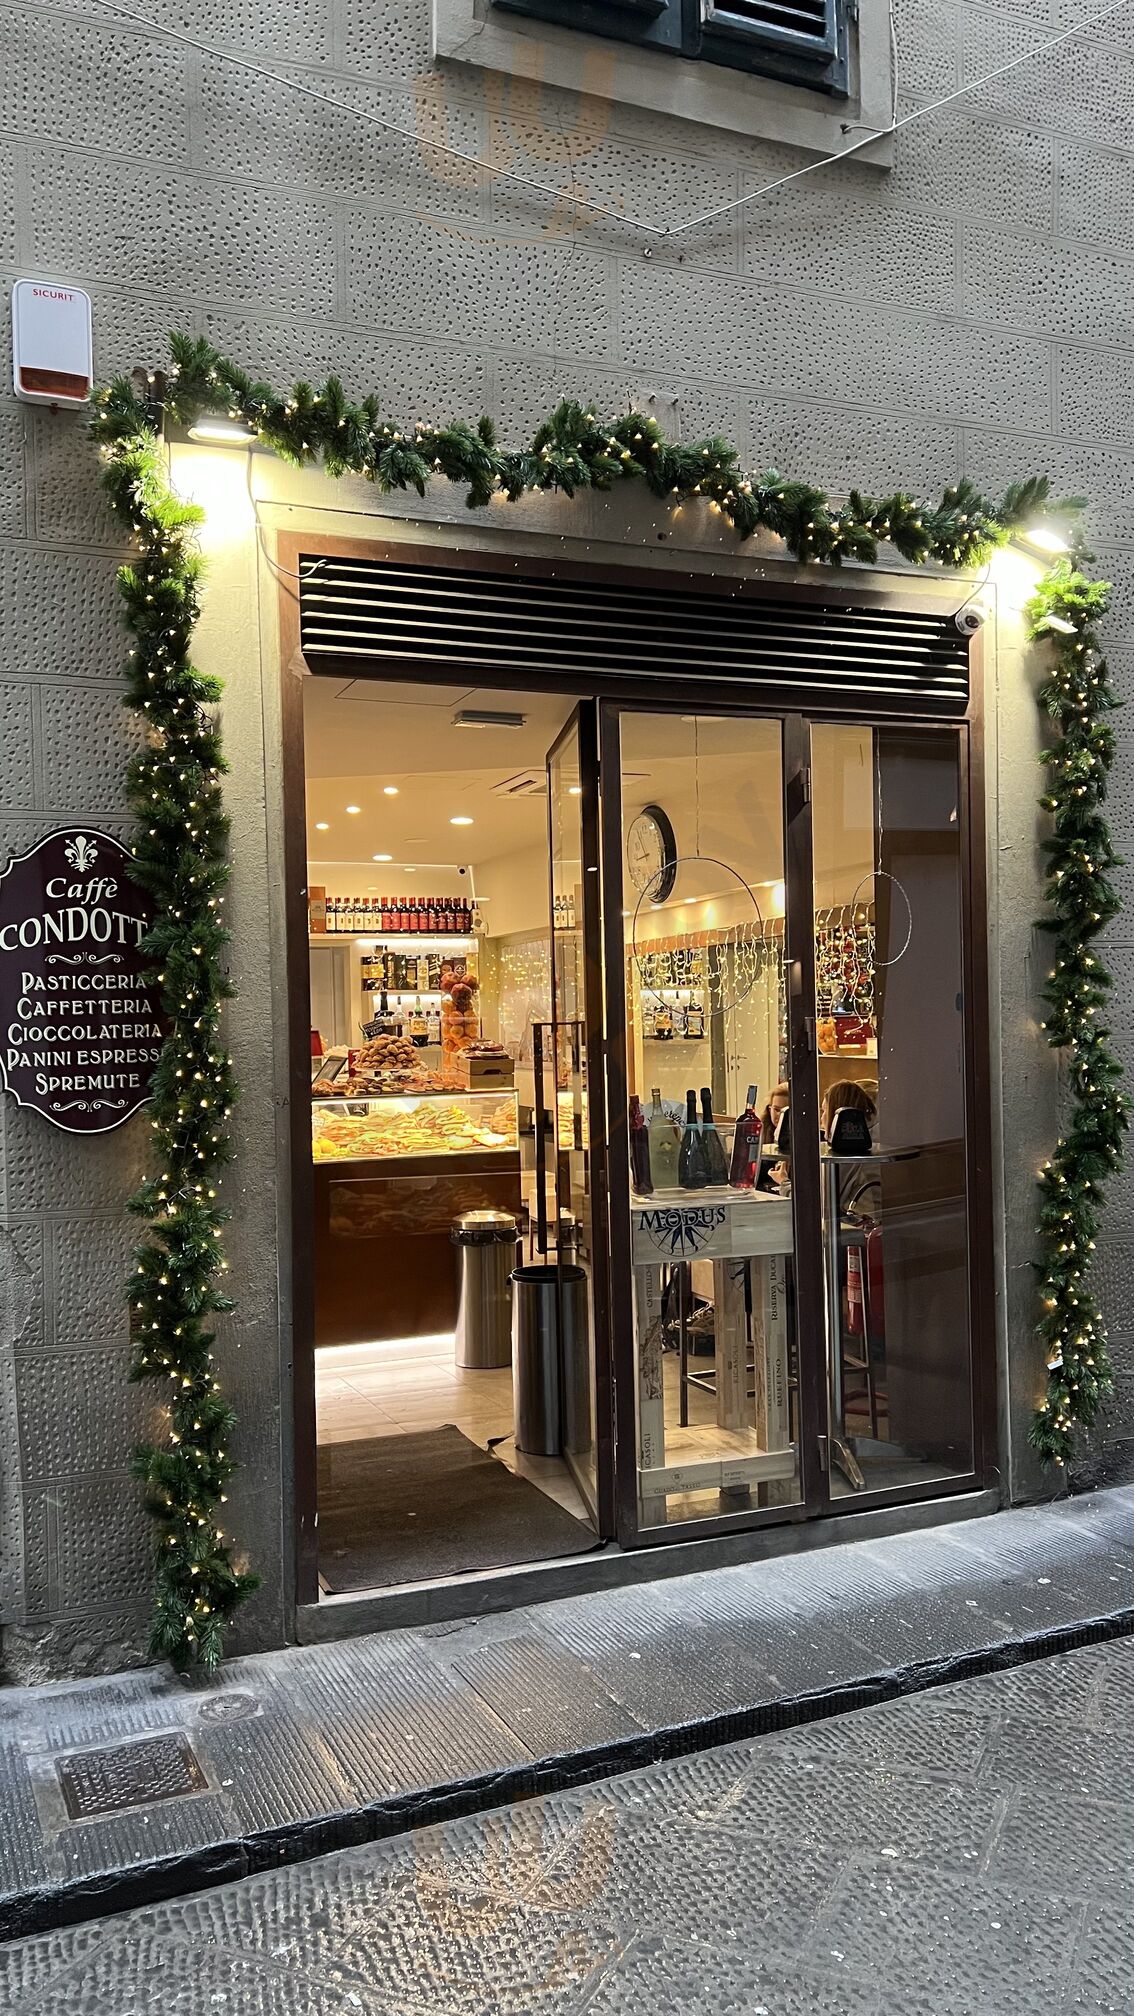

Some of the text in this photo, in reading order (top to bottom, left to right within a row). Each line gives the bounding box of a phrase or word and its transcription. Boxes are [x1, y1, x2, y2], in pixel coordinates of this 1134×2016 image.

[32, 288, 74, 301] SICURIT
[46, 877, 118, 905] Caffè
[0, 907, 149, 951] CONDOTT
[21, 971, 148, 994] PASTICCERIA
[17, 997, 153, 1020] CAFFETTERIA
[7, 1023, 163, 1045] CIOCCOLATERIA
[6, 1048, 71, 1071] PANINI
[35, 1072, 141, 1095] SPREMUTE
[638, 1206, 726, 1231] MODUS
